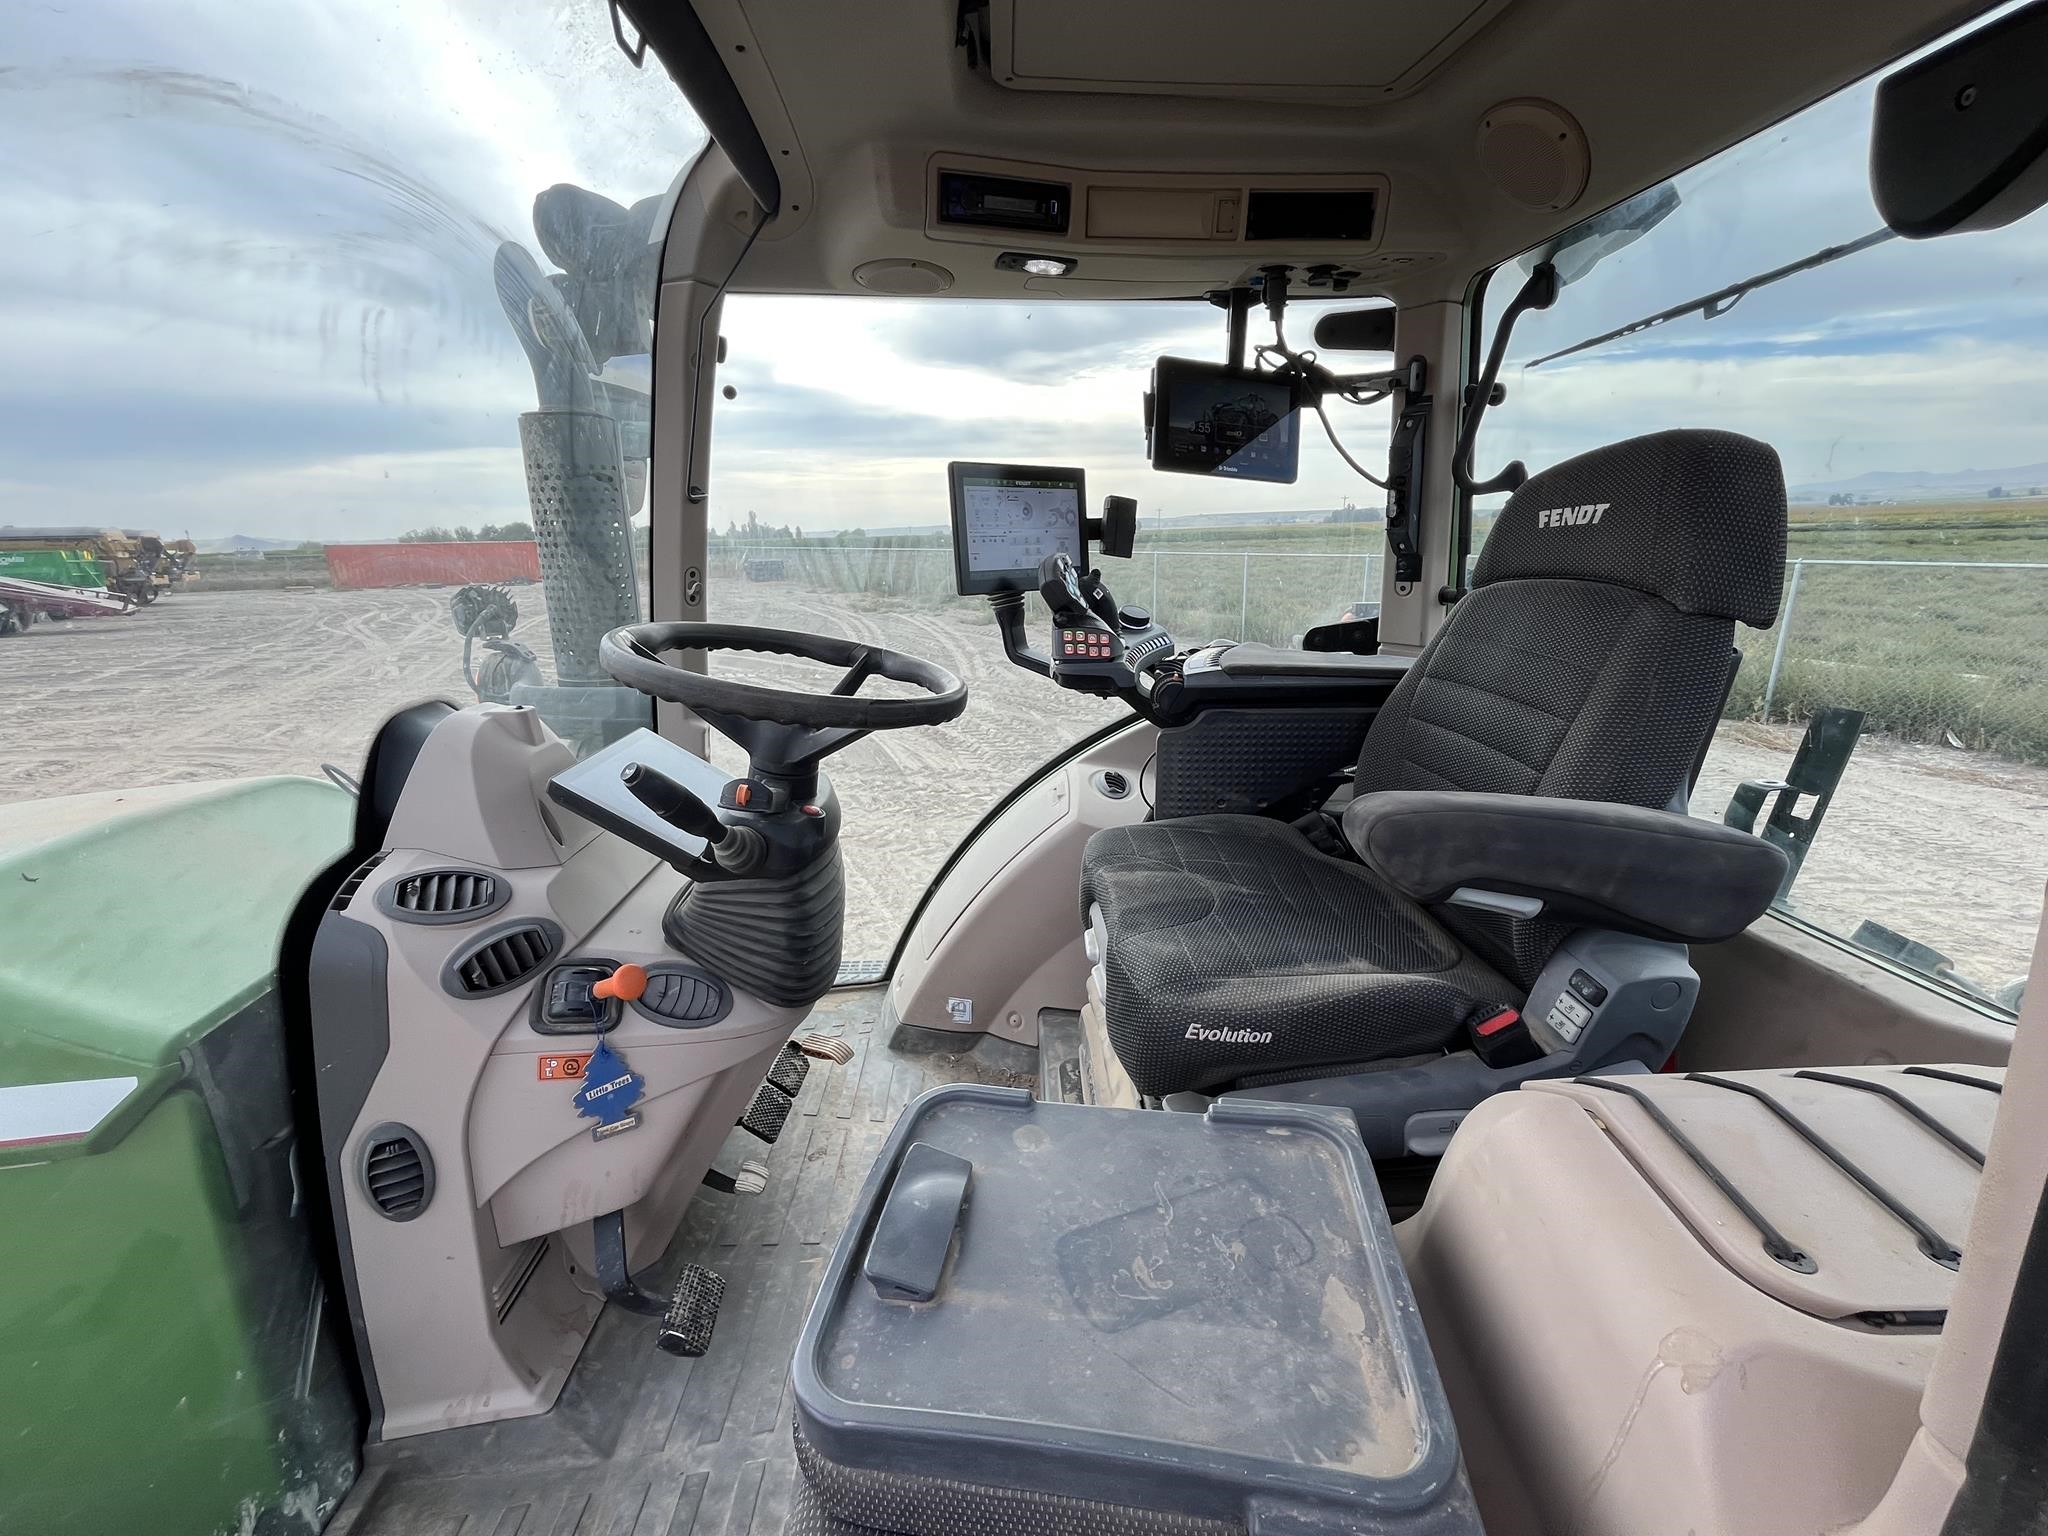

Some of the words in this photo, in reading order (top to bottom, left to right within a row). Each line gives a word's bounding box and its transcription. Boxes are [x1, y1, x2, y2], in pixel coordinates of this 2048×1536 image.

[1538, 503, 1611, 528] FENDT
[1184, 1023, 1273, 1043] Evolution
[588, 1086, 609, 1099] Little
[610, 1076, 630, 1088] Trees
